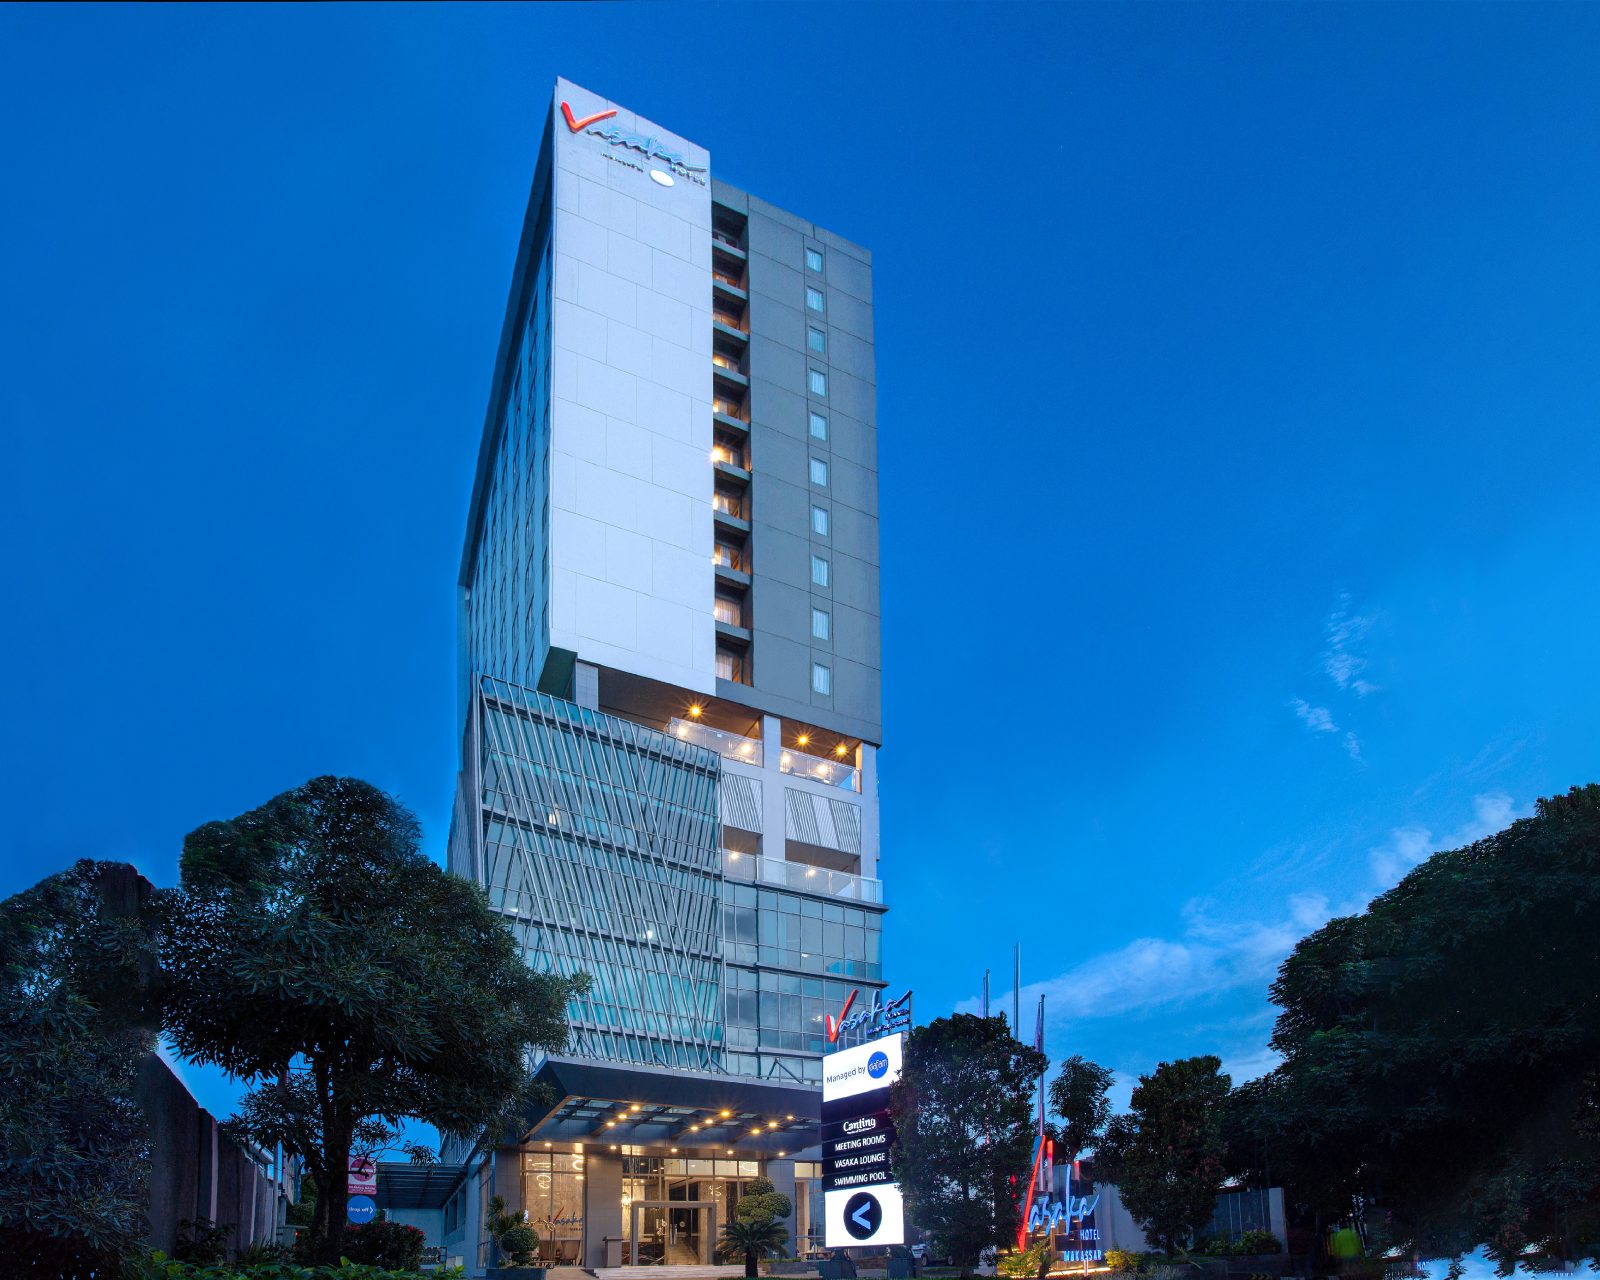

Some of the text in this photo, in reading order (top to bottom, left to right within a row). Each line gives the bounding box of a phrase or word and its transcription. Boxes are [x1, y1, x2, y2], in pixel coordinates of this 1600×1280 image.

[825, 989, 912, 1043] Vasaka
[826, 1068, 857, 1084] Managed
[857, 1066, 866, 1075] by
[843, 1117, 876, 1131] Canting
[834, 1134, 886, 1152] MEETING ROOMS
[834, 1152, 886, 1169] VASAKA LOUNGE
[834, 1171, 887, 1187] SWIMMING POOL
[1080, 1228, 1101, 1240] HOTEL
[1063, 1249, 1102, 1262] MAKASSAR
